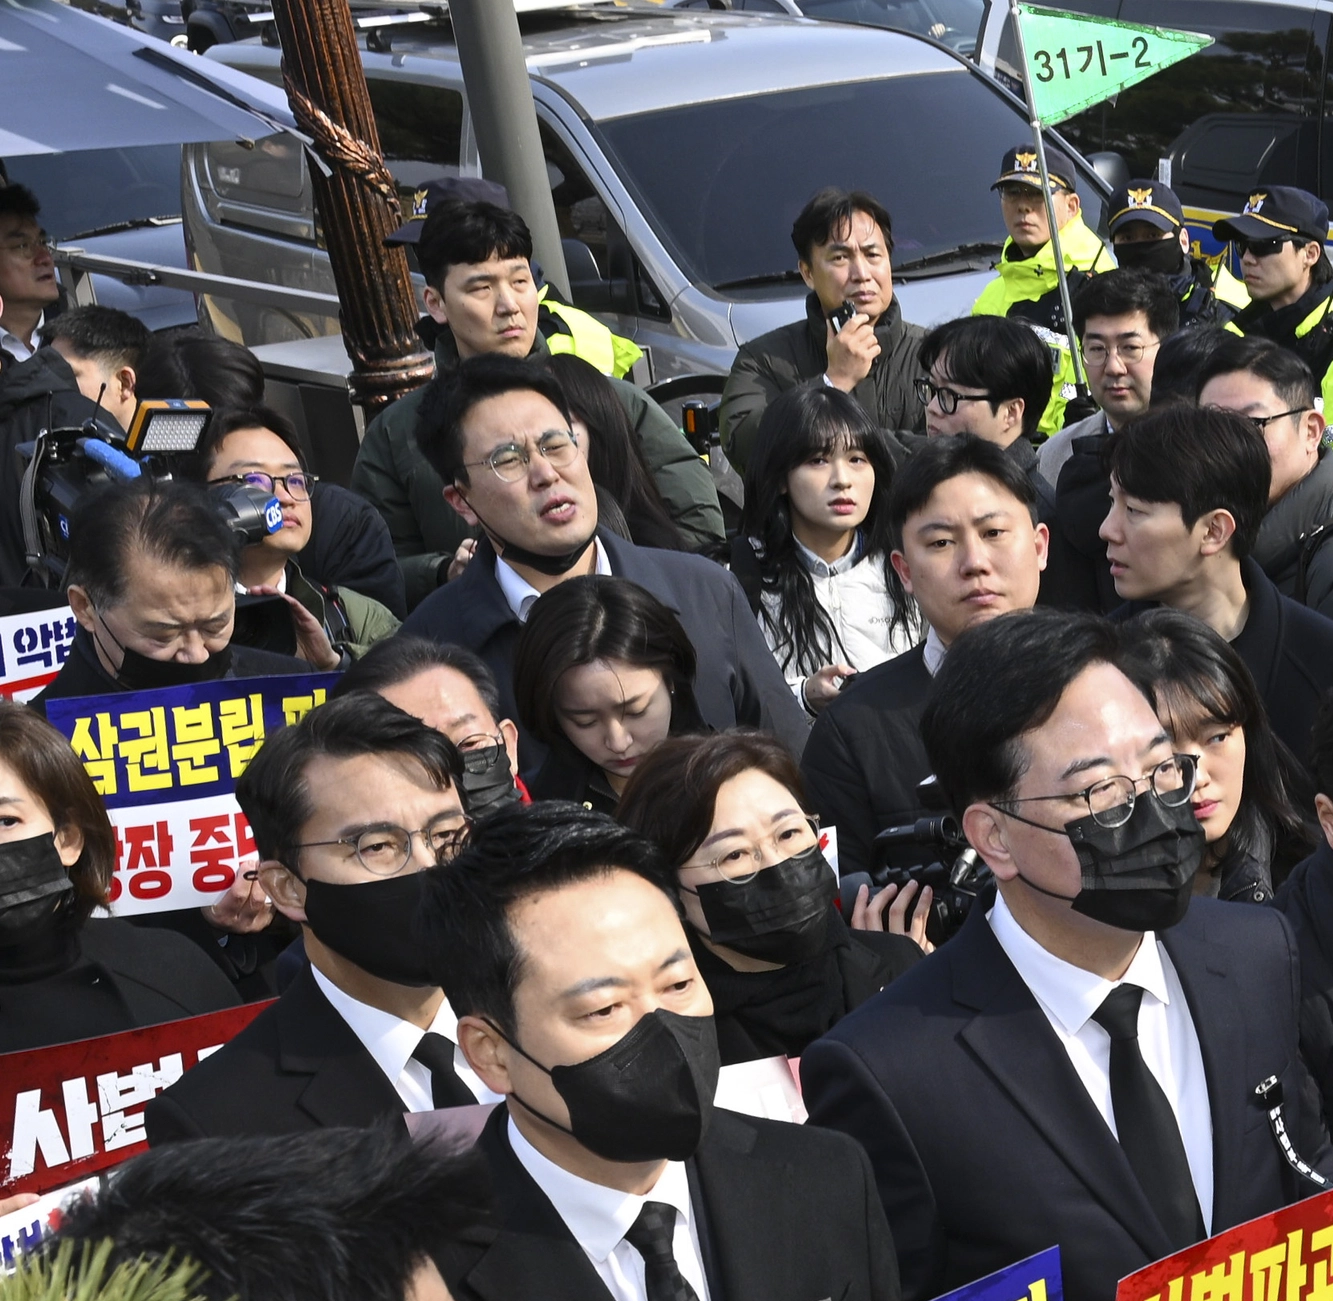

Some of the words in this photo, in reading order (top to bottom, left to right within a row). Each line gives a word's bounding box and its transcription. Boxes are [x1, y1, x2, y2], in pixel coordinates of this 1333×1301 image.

[1034, 36, 1151, 83] 31기-2
[265, 502, 282, 528] CBS
[70, 693, 265, 796] 삼권분립
[10, 1043, 226, 1178] 사법
